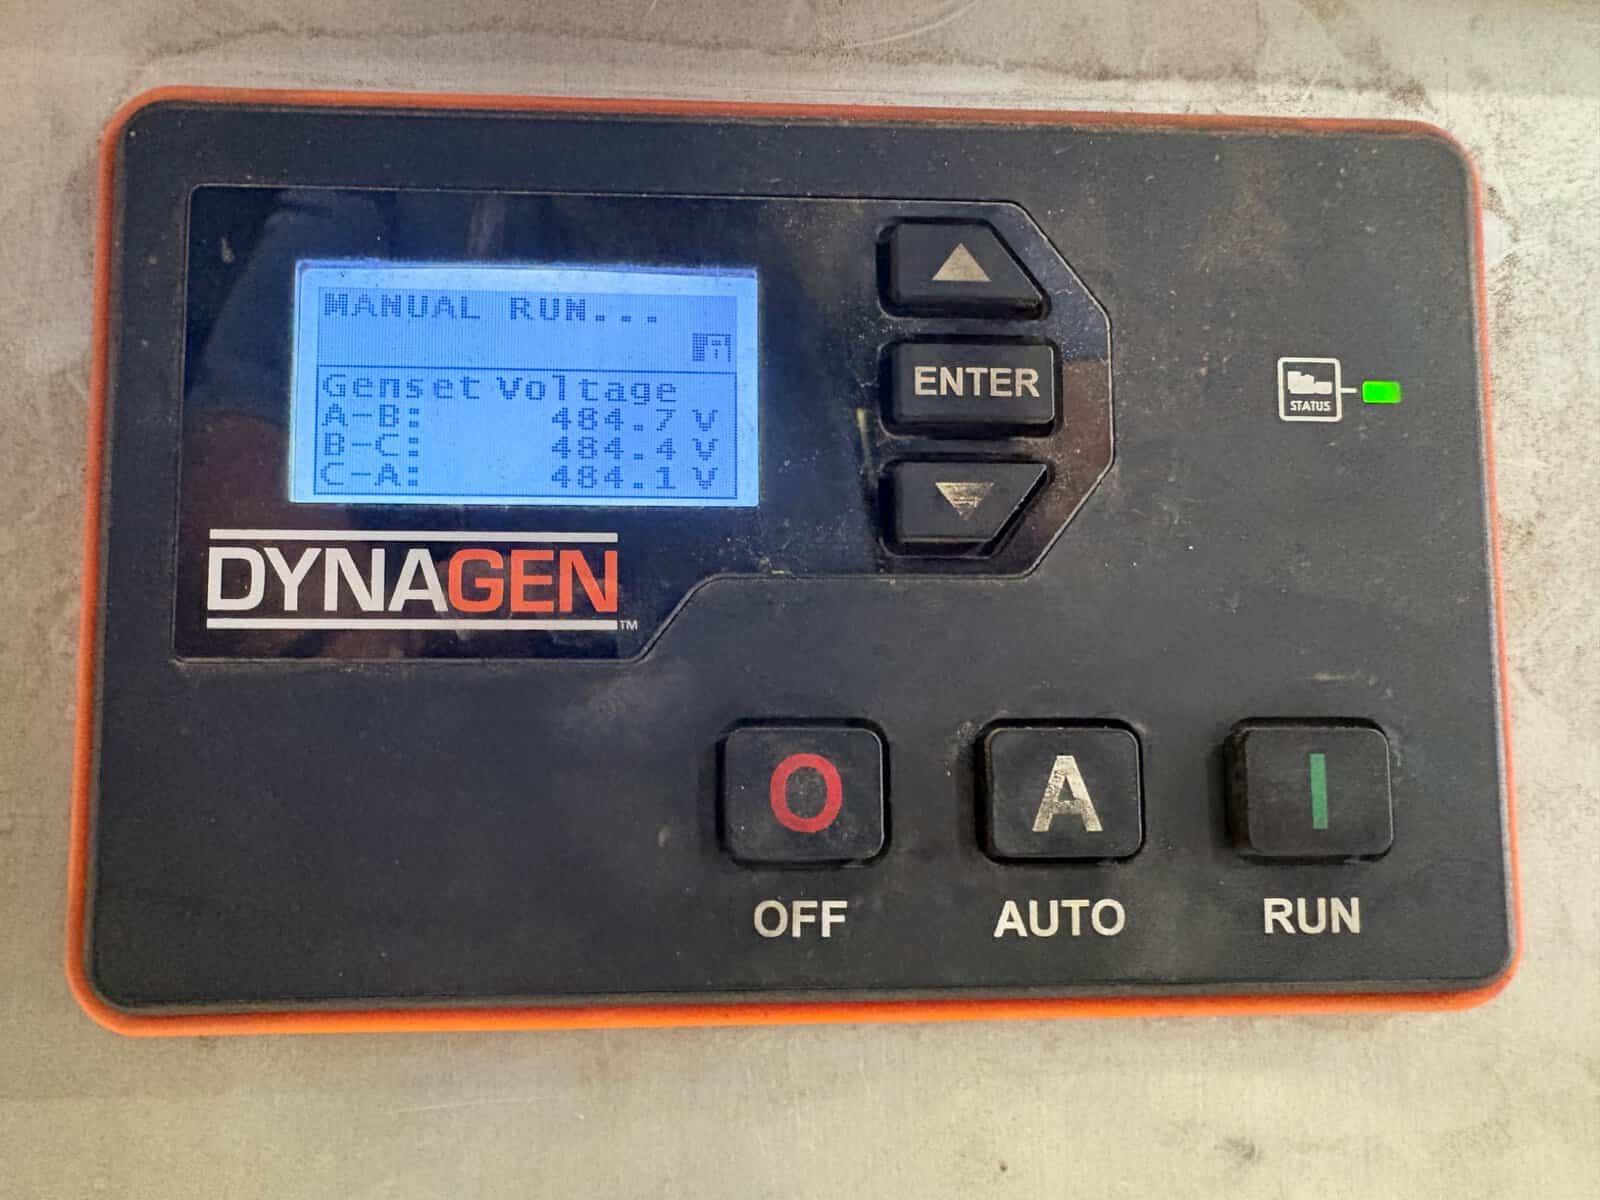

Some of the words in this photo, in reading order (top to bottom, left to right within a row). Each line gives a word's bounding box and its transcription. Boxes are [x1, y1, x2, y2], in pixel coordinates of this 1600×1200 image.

[323, 292, 481, 321] MANUAL
[510, 297, 657, 323] RUN...
[321, 374, 481, 400] Genset
[914, 366, 1040, 397] ENTER
[321, 403, 419, 428] A-B:
[551, 407, 677, 431] 484.7
[1290, 400, 1331, 412] STATUS
[323, 432, 419, 457] B-C:
[551, 436, 677, 460] 484.4
[320, 462, 419, 487] C-A:
[551, 465, 677, 489] 484.1
[207, 546, 618, 613] DYNAGEN
[1032, 755, 1103, 833] A
[753, 899, 848, 938] OFF
[994, 898, 1126, 937] AUTO
[1265, 897, 1361, 935] RUN
